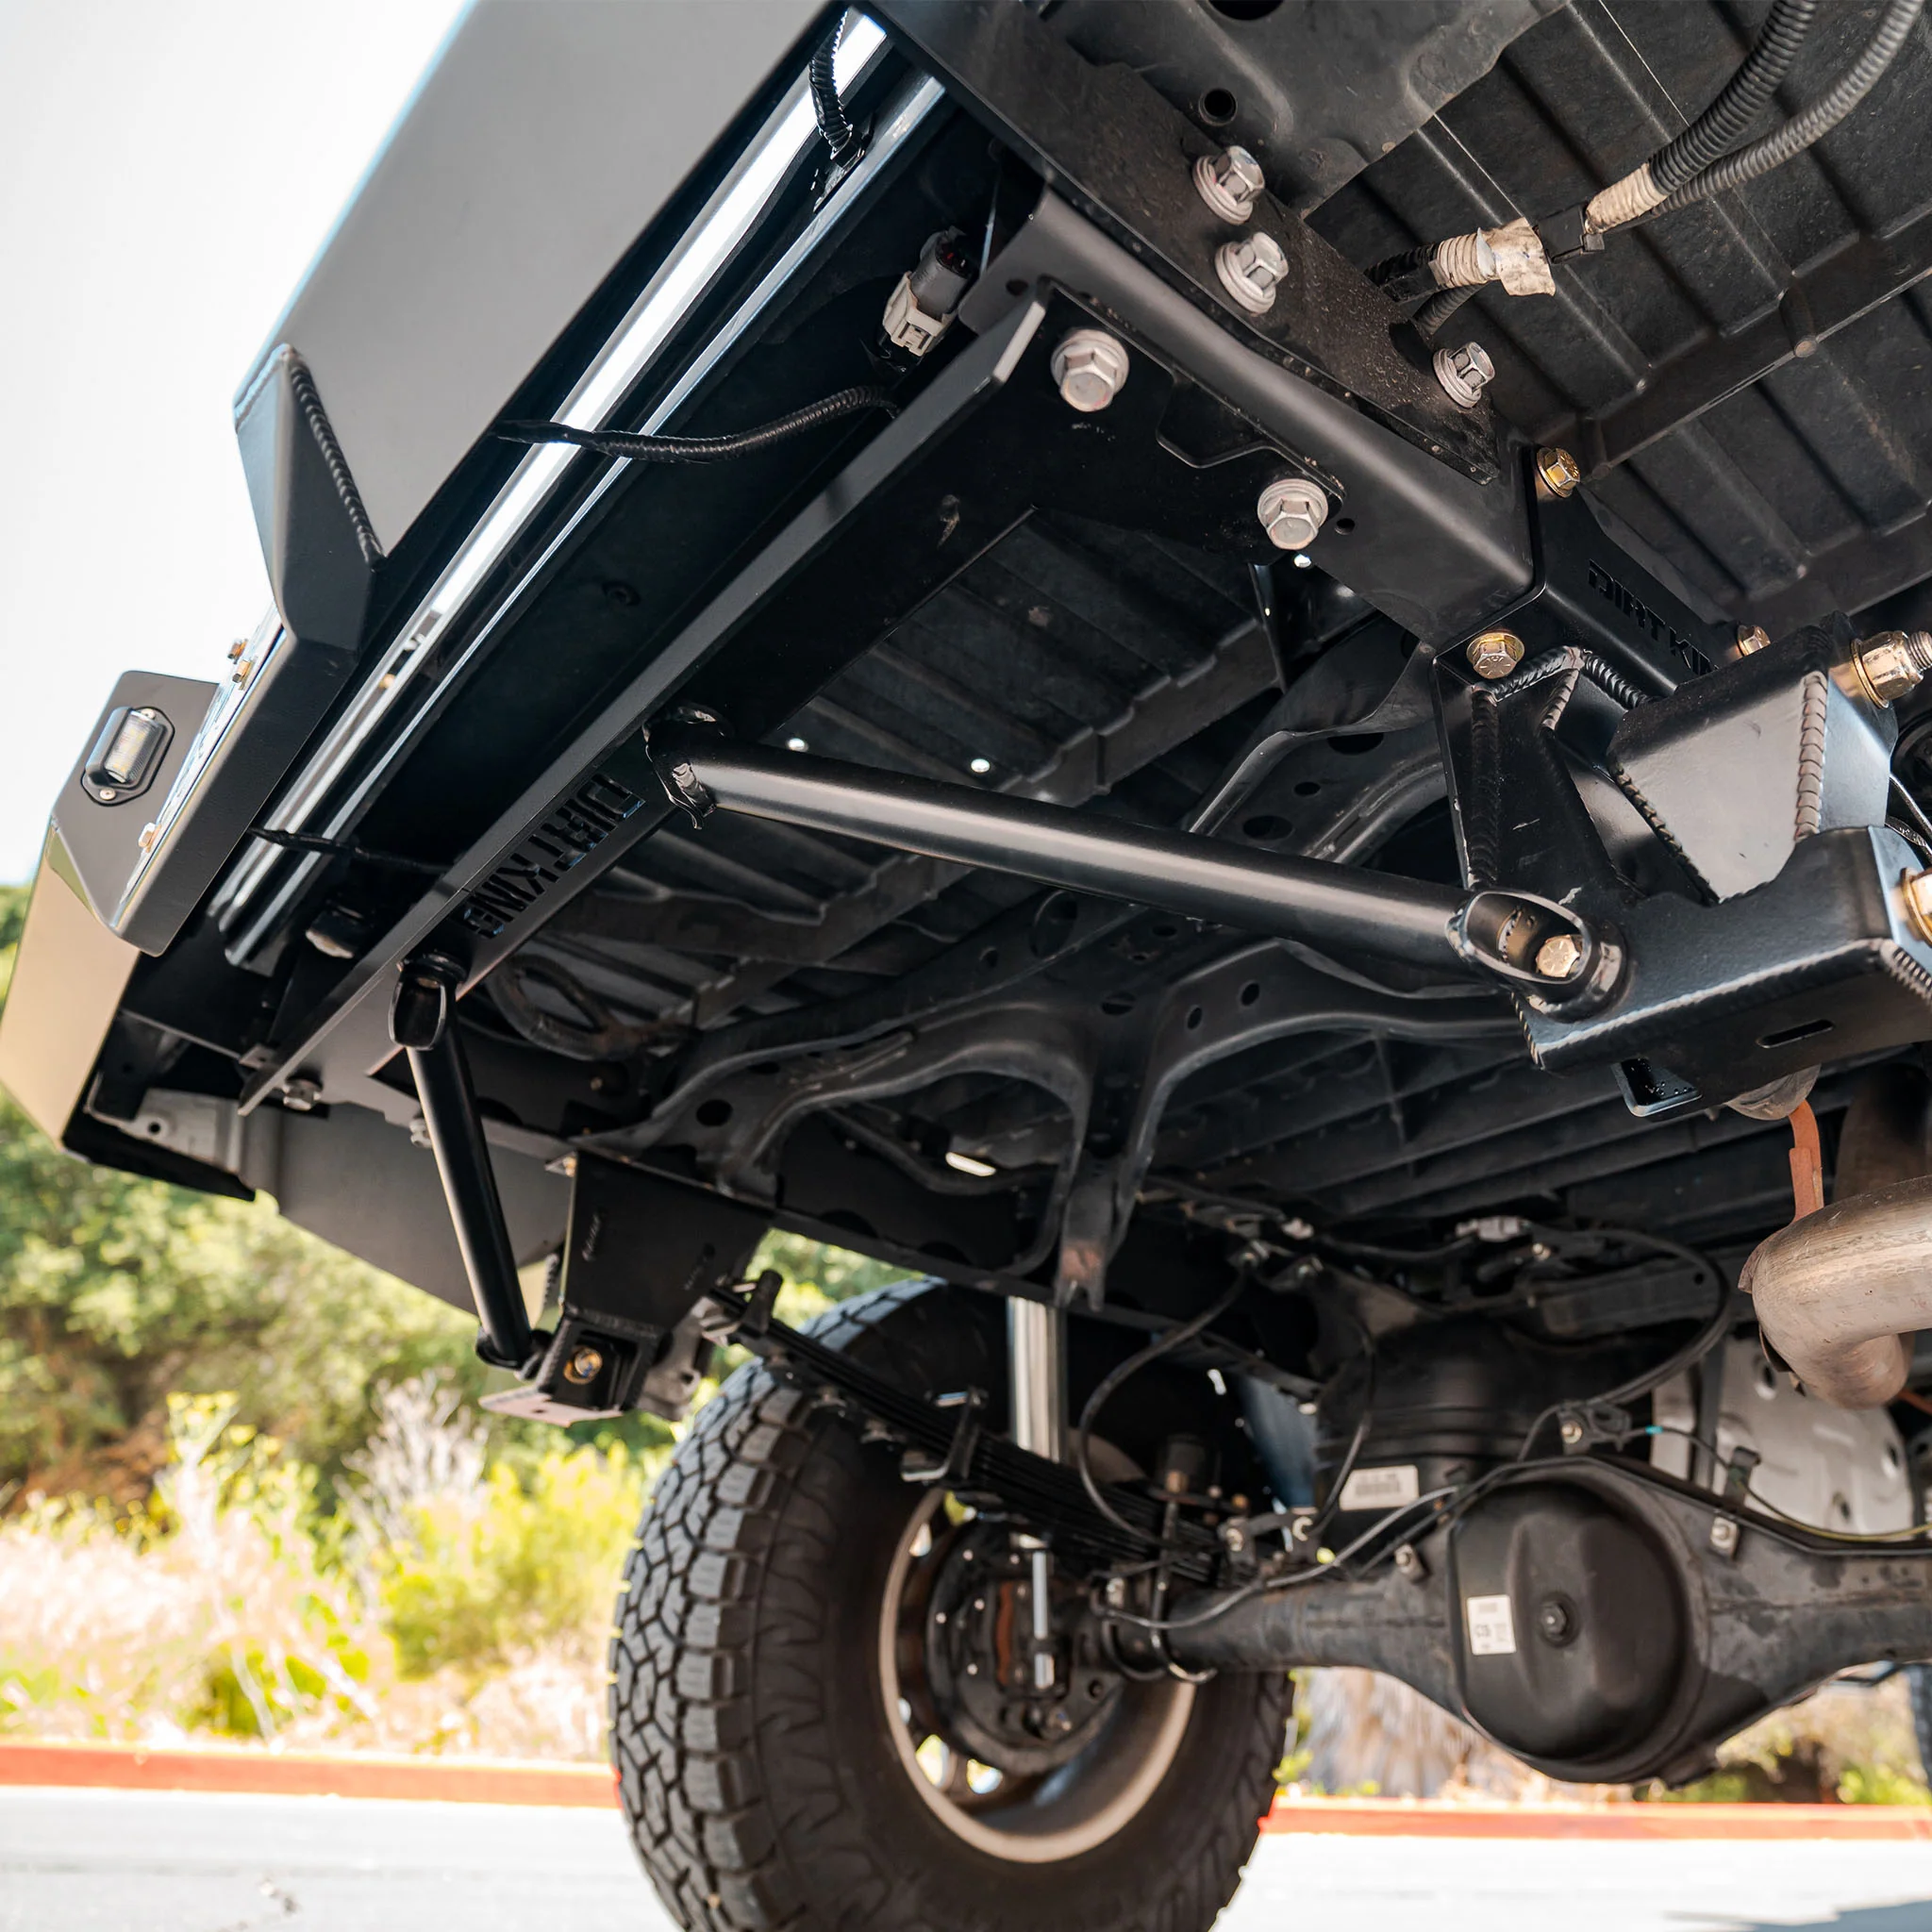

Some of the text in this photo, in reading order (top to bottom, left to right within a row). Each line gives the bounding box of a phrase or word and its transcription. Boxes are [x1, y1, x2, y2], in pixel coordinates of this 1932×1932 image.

[1589, 558, 1719, 676] DIRT KIN
[463, 774, 646, 939] DIRT KING
